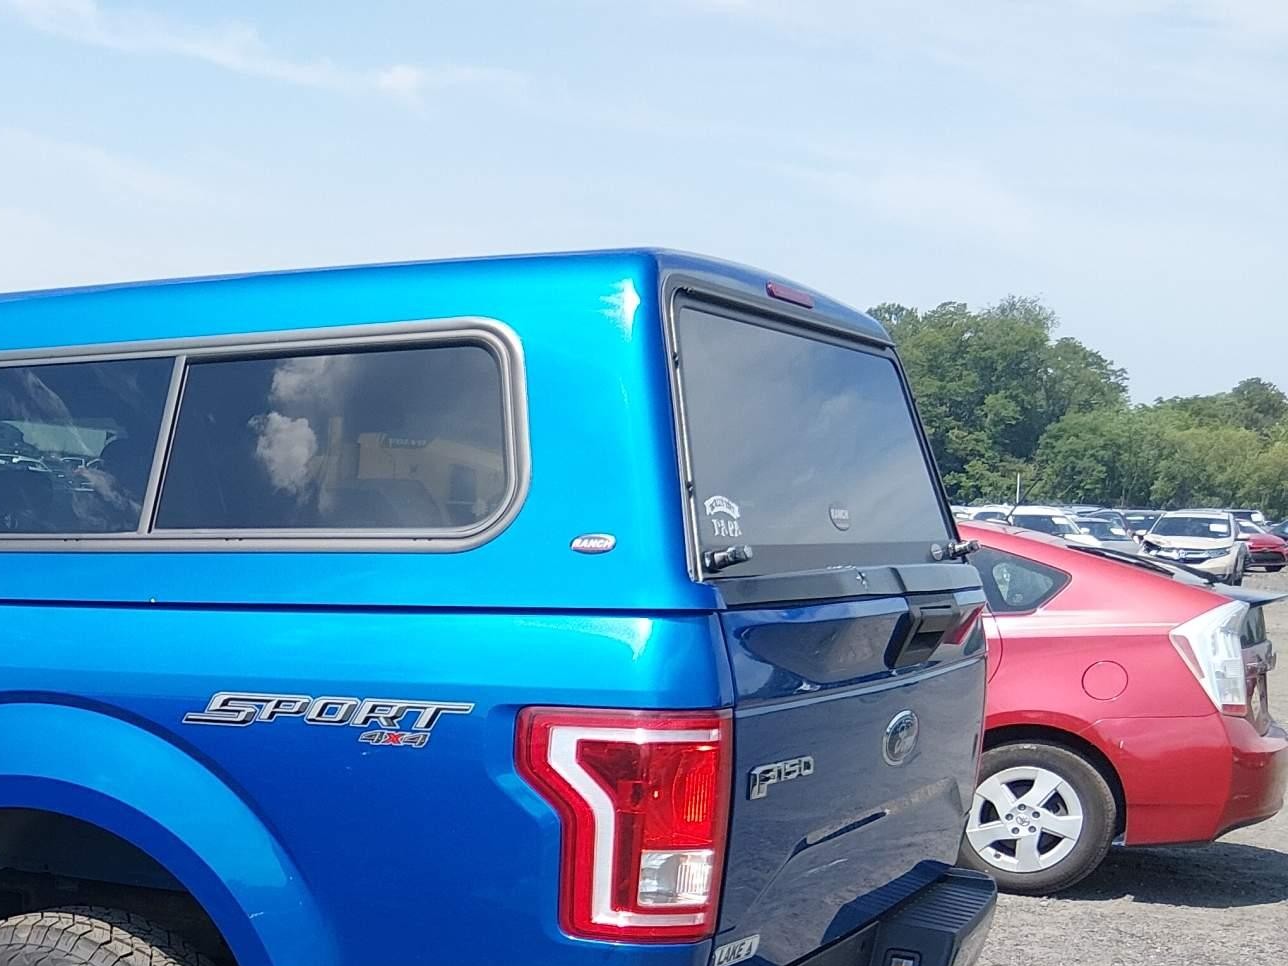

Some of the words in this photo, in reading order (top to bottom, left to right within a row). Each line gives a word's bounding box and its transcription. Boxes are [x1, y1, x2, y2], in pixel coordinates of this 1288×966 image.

[711, 518, 742, 537] PAPA
[182, 691, 474, 730] SPORT
[749, 755, 815, 801] F150
[716, 941, 746, 966] LAKE
